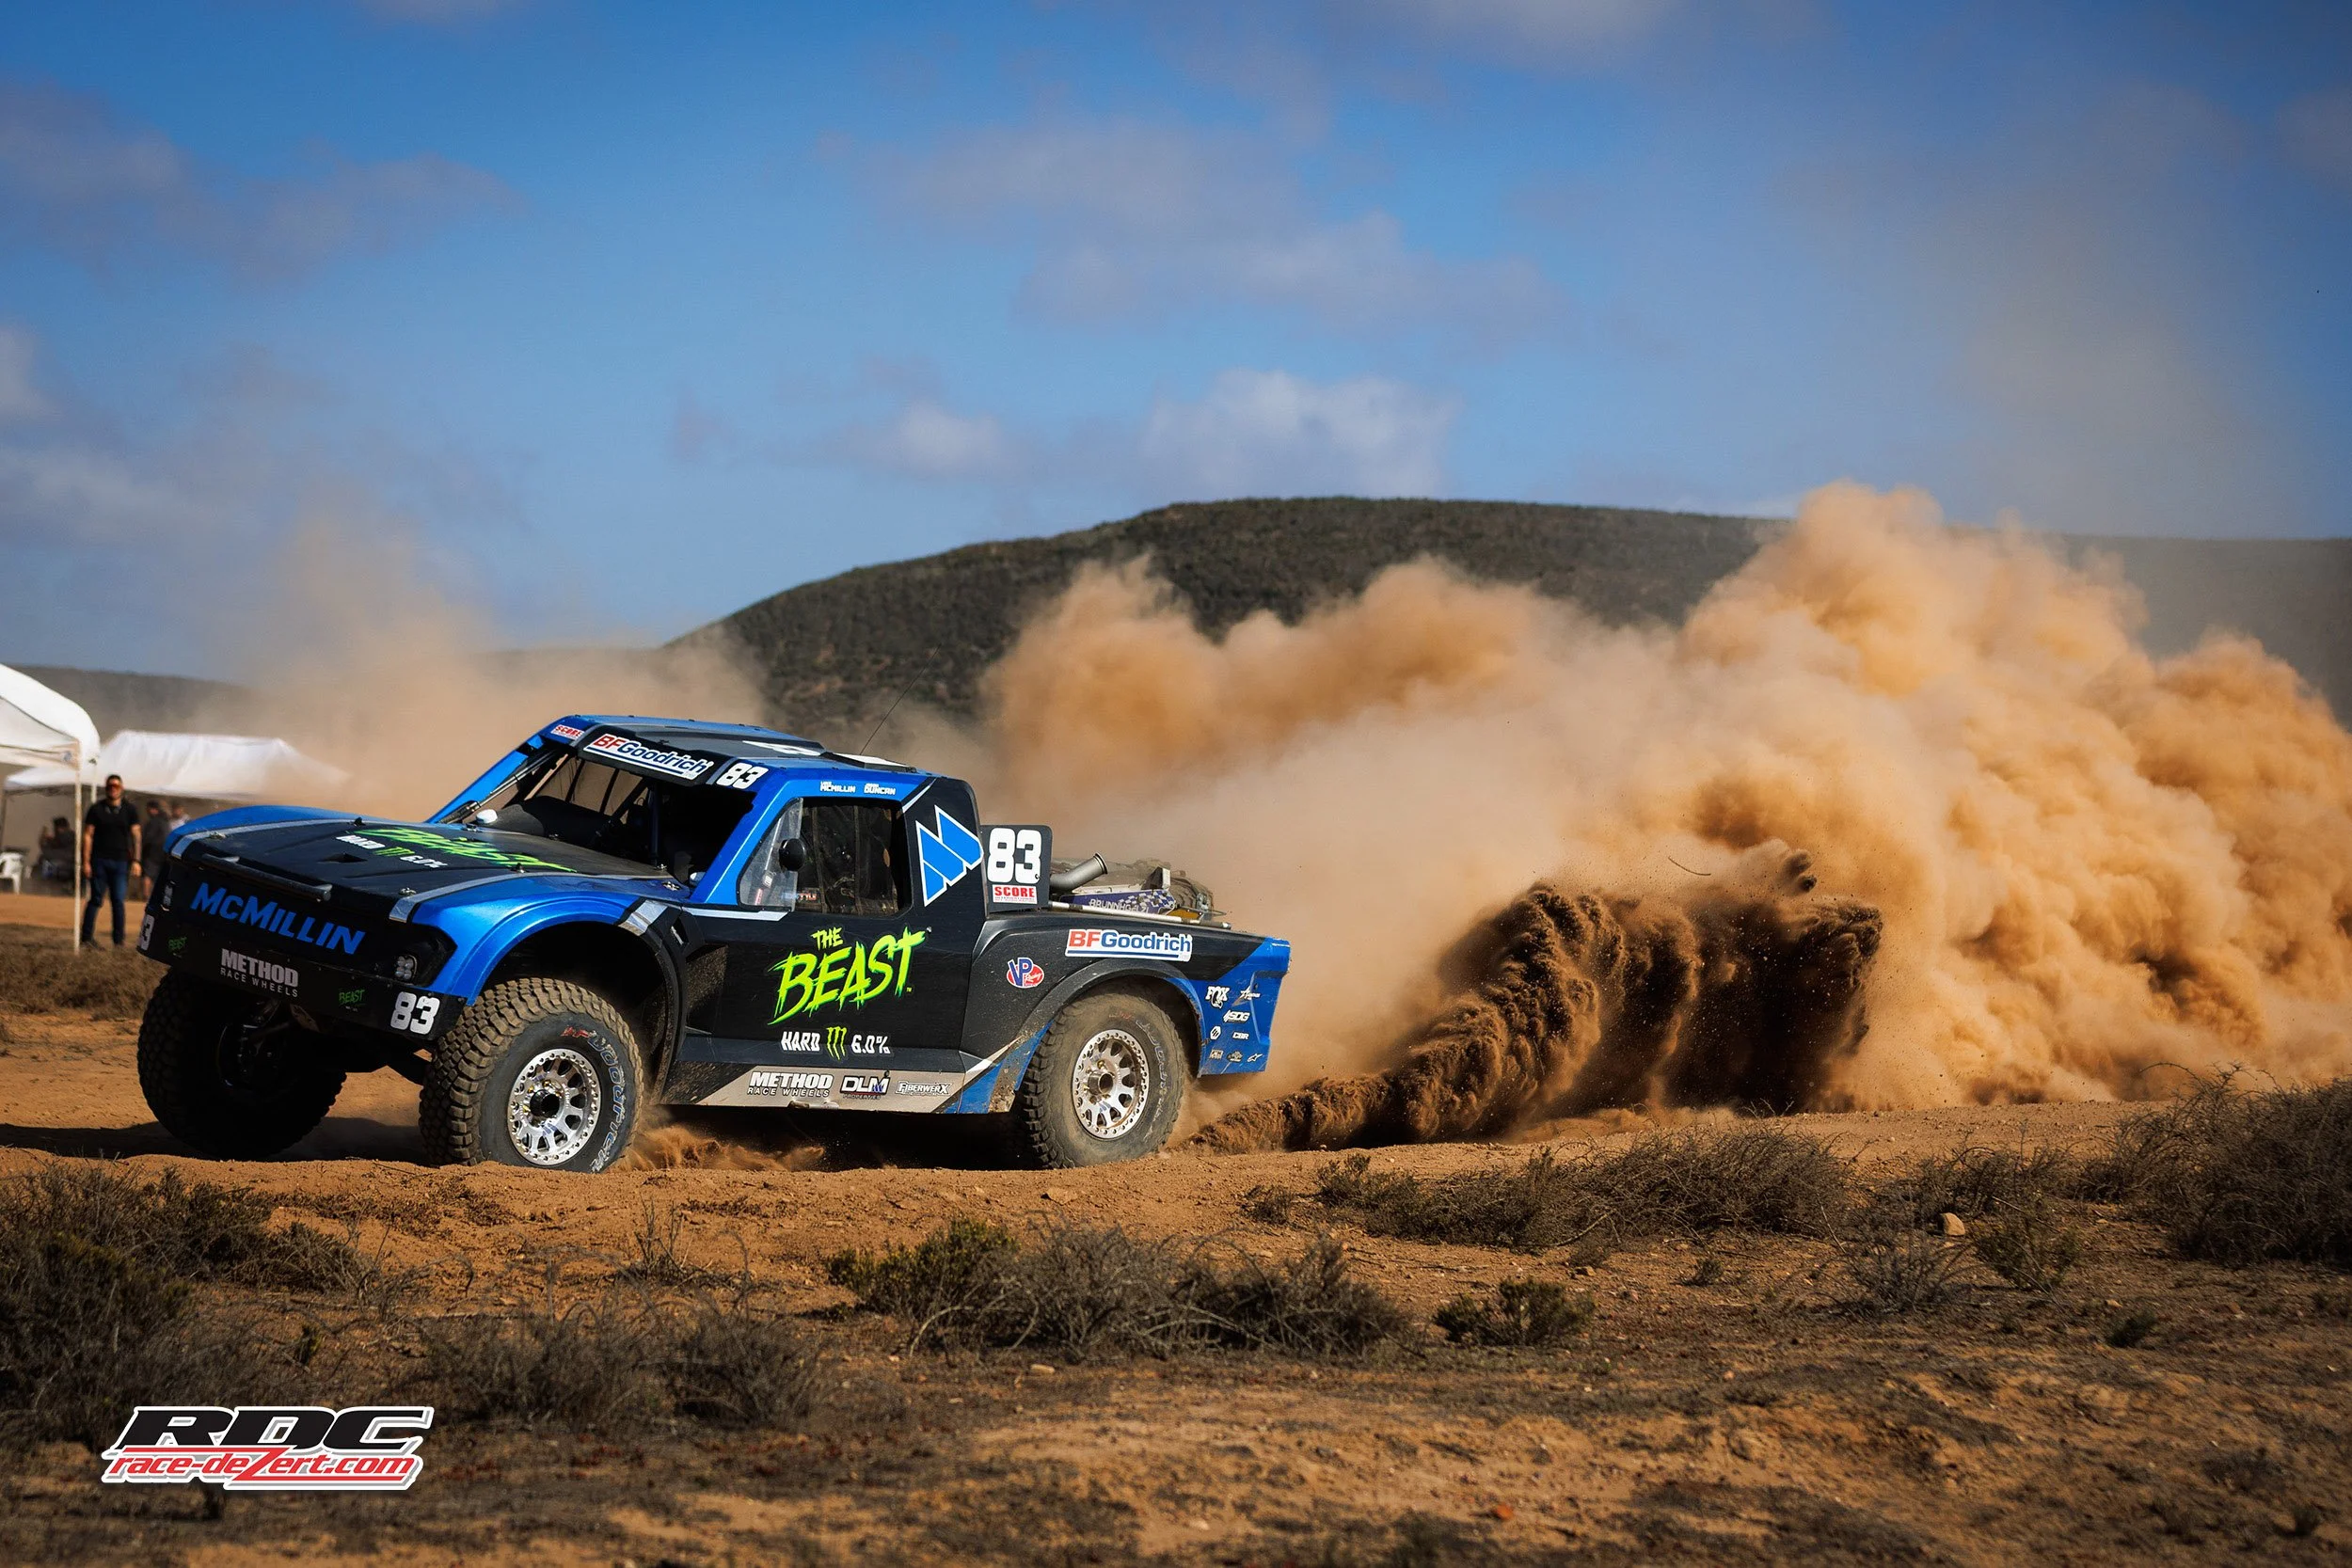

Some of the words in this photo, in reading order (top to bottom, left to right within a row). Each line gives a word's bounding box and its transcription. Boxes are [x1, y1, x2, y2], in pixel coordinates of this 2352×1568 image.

[555, 725, 581, 736] SCORE
[593, 735, 708, 773] BFGoodrich
[716, 762, 769, 789] 83
[988, 828, 1041, 884] 83
[994, 886, 1035, 897] SCORE
[810, 927, 844, 951] THE
[1068, 930, 1190, 953] BFGoodrich
[221, 948, 298, 988] METHOD
[767, 926, 926, 1025] BEAST
[1009, 958, 1033, 987] VP
[220, 967, 246, 983] RACE
[251, 976, 298, 998] WHEELS
[1205, 986, 1230, 1006] FOX
[390, 991, 440, 1035] 83
[780, 1031, 820, 1052] HARD
[850, 1035, 891, 1054] 6.0%
[749, 1071, 834, 1089] METHOD
[841, 1076, 889, 1093] DLM
[783, 1089, 830, 1098] WHEELS
